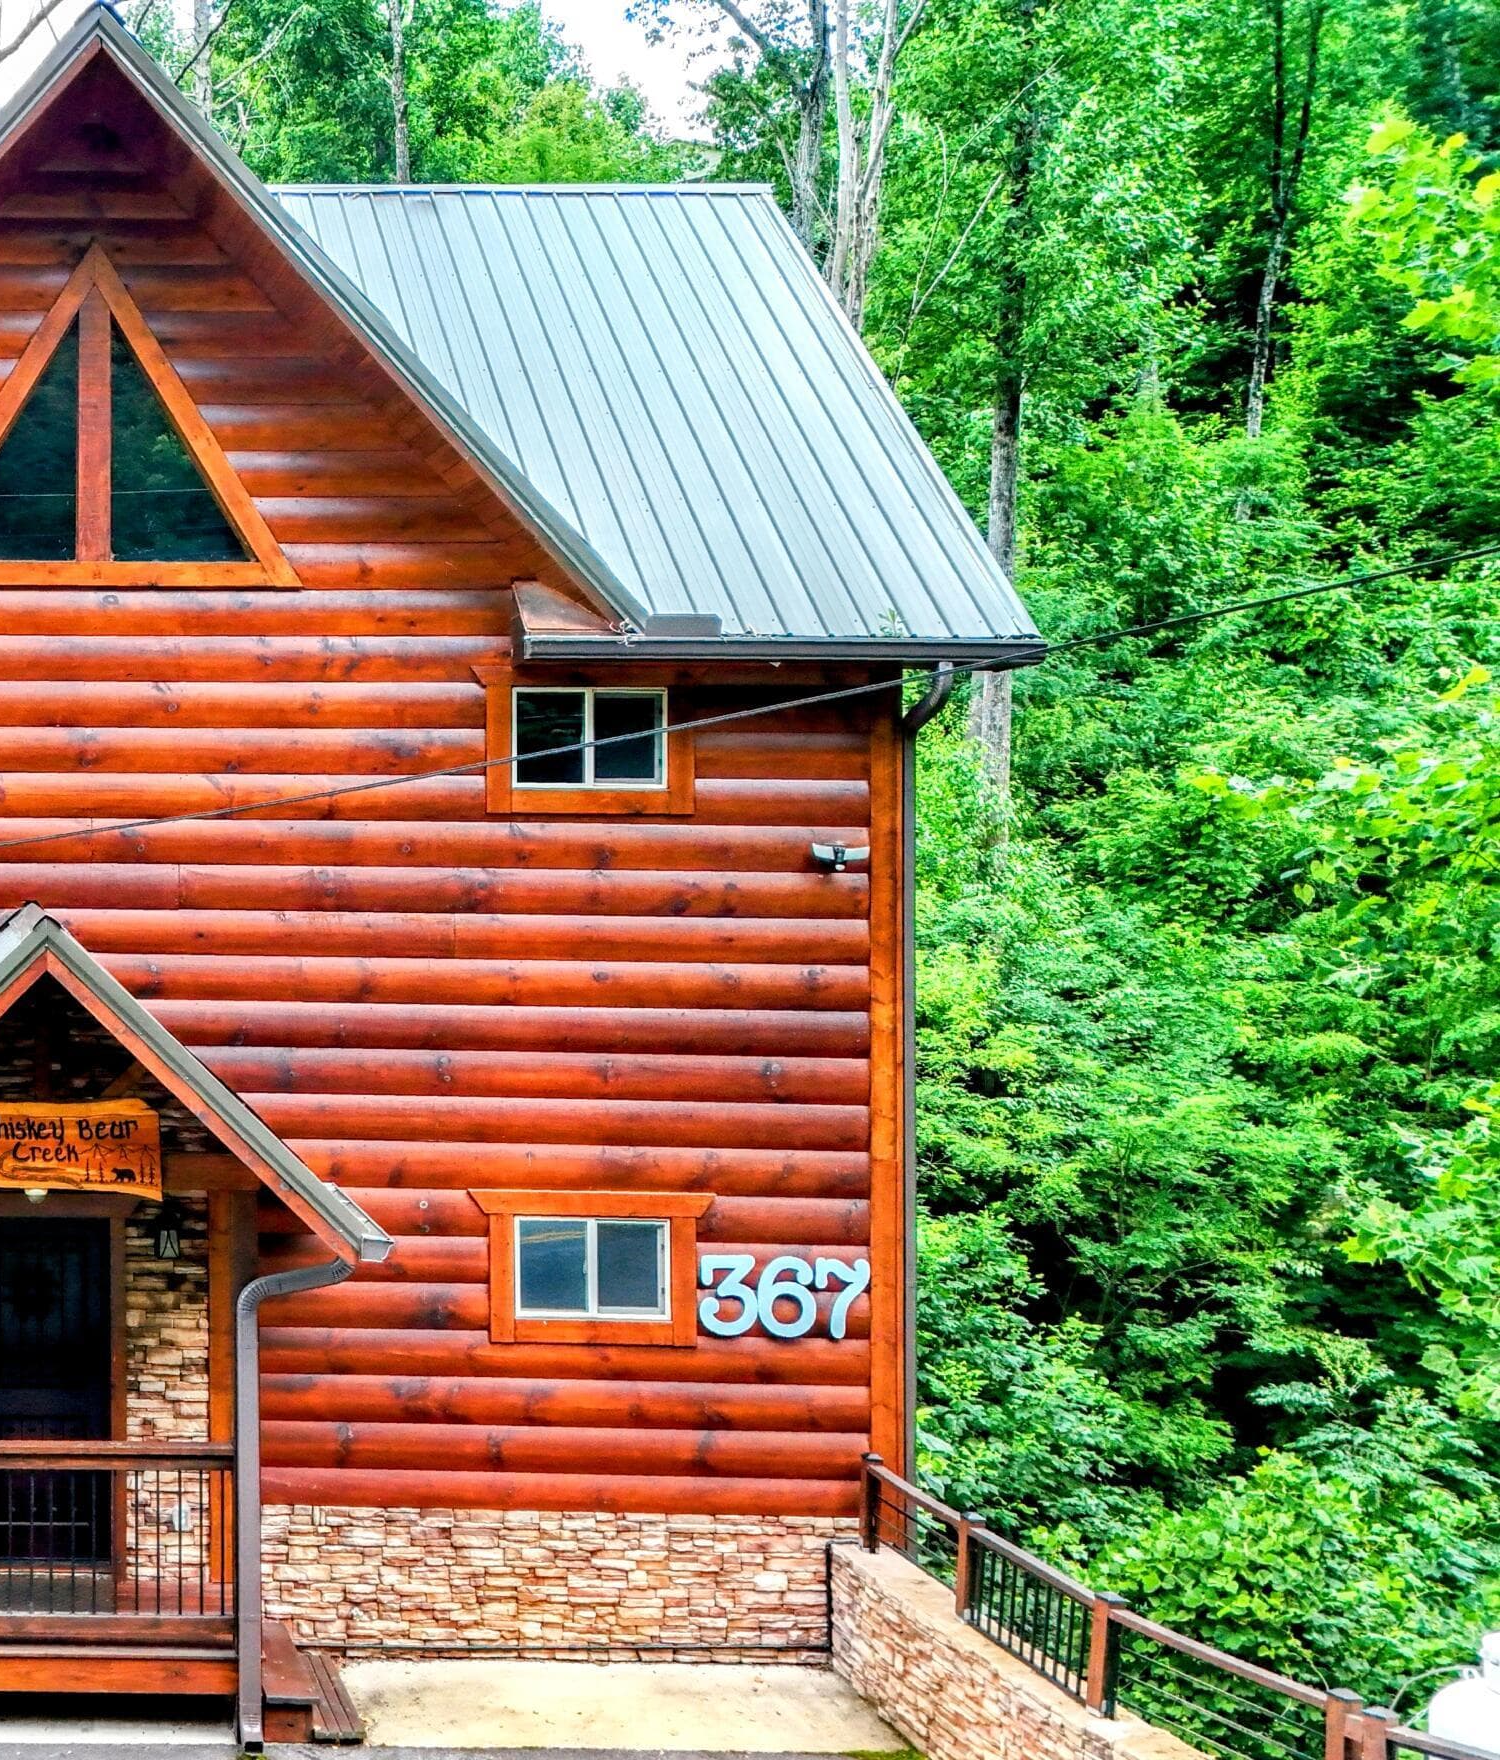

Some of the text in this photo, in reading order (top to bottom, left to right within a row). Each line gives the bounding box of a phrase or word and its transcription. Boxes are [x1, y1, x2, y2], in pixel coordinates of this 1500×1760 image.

[78, 1118, 138, 1140] Bear
[12, 1142, 79, 1162] Creek
[700, 1255, 871, 1339] 367
